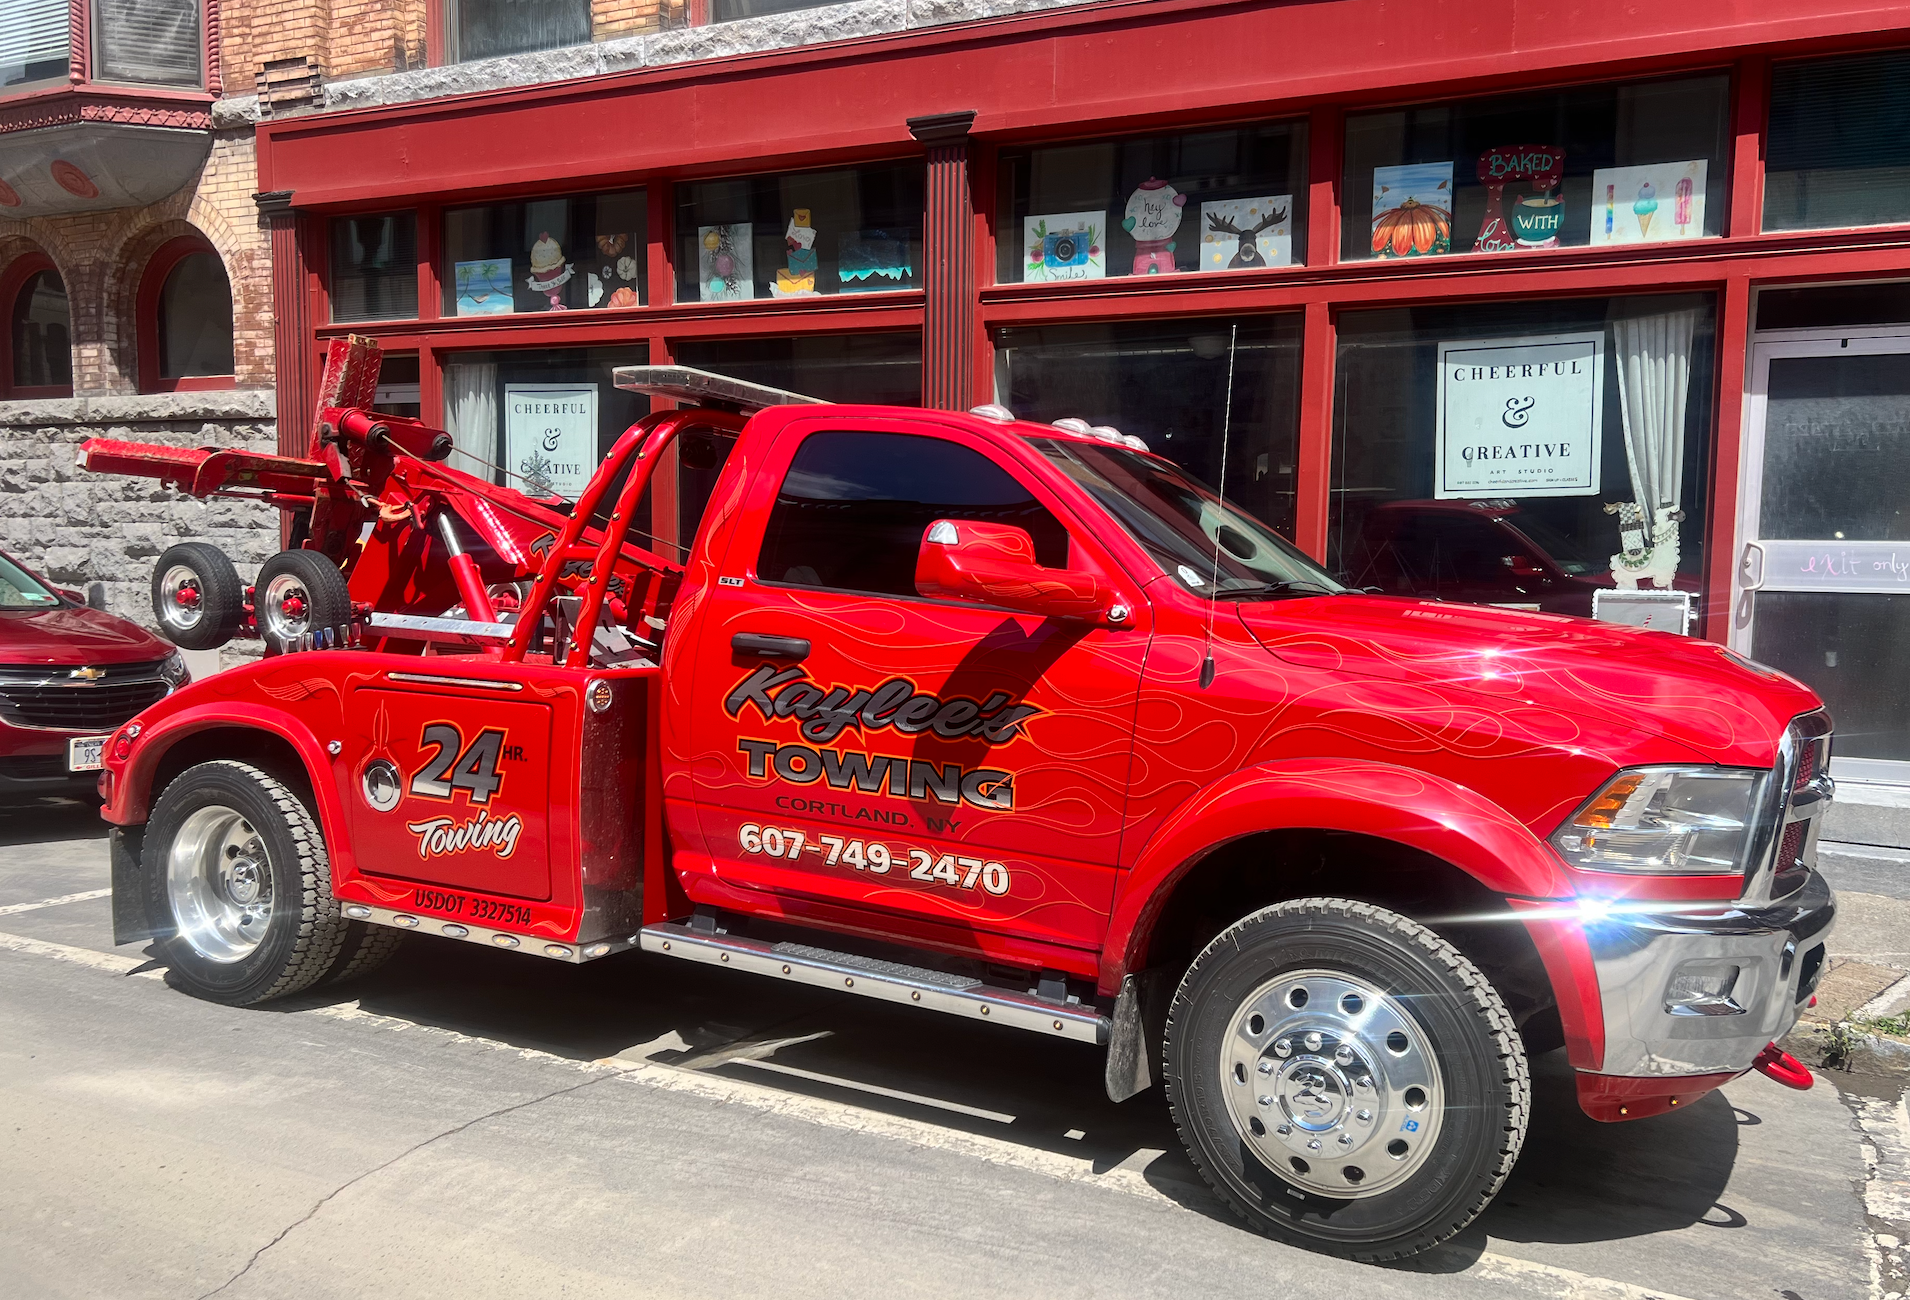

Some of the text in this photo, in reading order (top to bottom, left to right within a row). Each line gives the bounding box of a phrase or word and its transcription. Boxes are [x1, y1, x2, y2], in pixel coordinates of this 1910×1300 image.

[1488, 153, 1554, 176] BAKED
[1143, 198, 1166, 220] hey
[1139, 216, 1167, 228] love
[1516, 214, 1559, 230] WITH
[1453, 361, 1582, 382] CHEERFUL
[514, 403, 587, 414] CHEERFUL
[1501, 396, 1535, 429] &
[542, 427, 562, 452] &
[1461, 442, 1571, 461] CREATIVE
[520, 463, 581, 475] CATIVE
[1800, 551, 1910, 581] exit only
[720, 577, 743, 586] SLT
[724, 663, 1048, 746] Kaylee's
[408, 721, 528, 806] 24 HR.
[738, 737, 1015, 811] TOWING
[407, 809, 522, 858] Towing
[926, 815, 962, 834] NY
[739, 822, 1010, 896] 607-749-2470
[415, 889, 532, 926] USDOT 3327514
